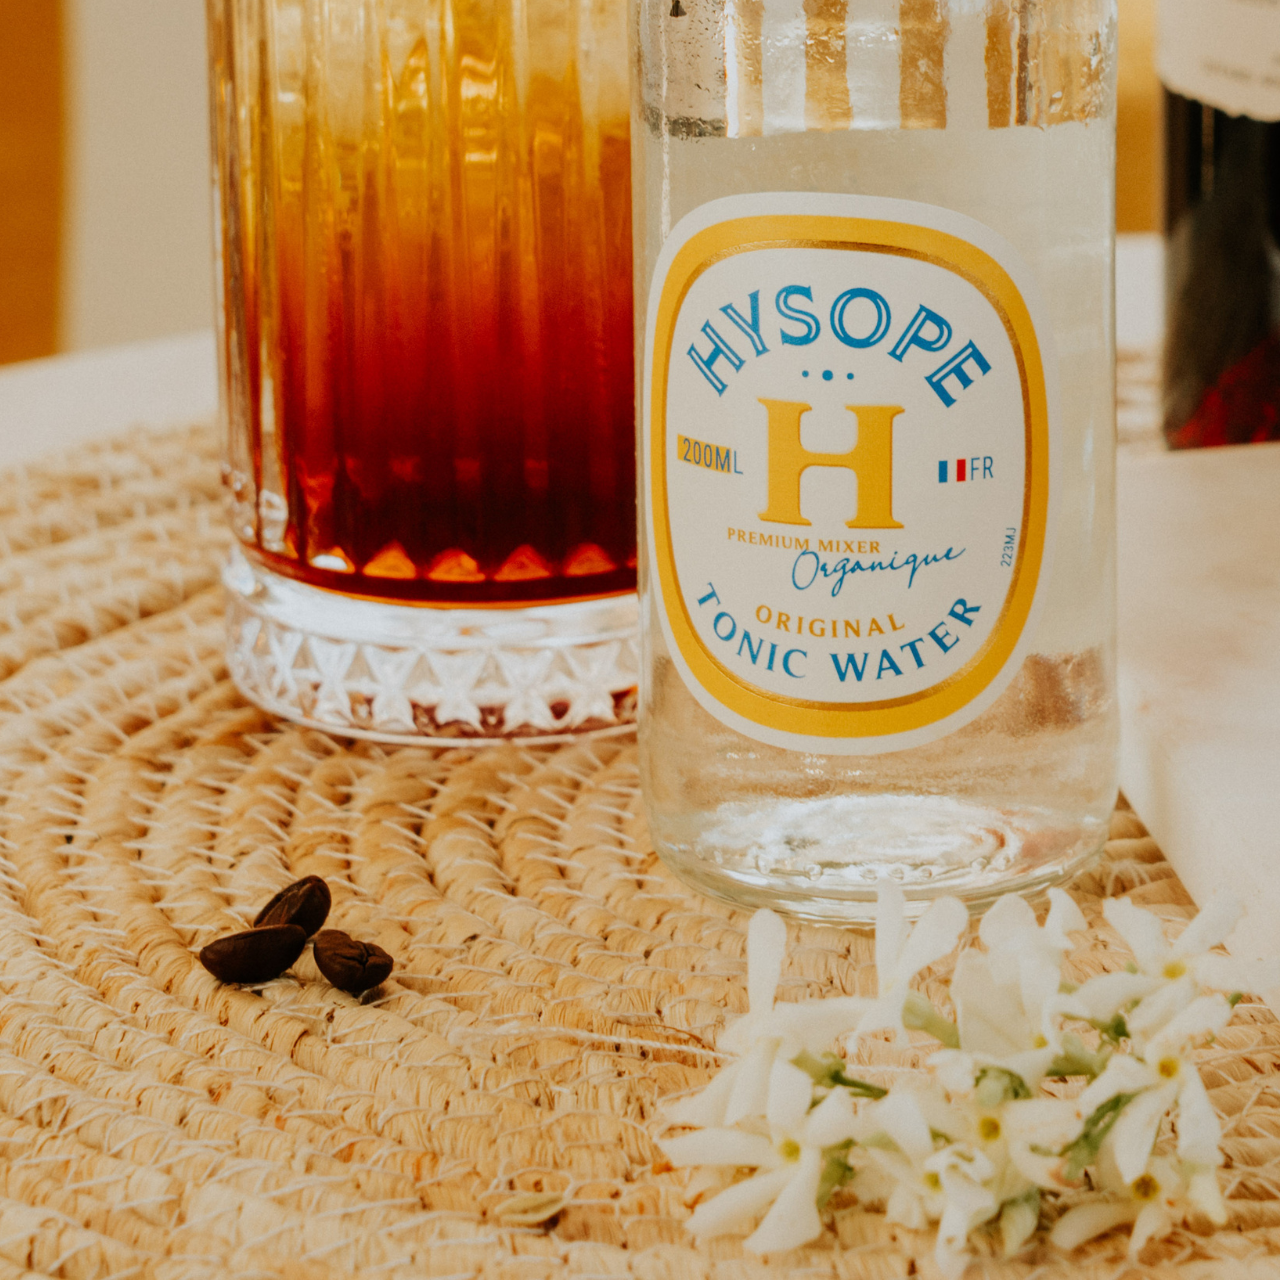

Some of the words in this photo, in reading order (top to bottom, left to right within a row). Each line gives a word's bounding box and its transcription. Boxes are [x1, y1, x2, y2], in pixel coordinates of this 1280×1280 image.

[686, 284, 992, 408] HYSOPE
[682, 437, 744, 475] 200ML
[757, 397, 905, 529] H
[970, 456, 994, 482] FR
[727, 526, 810, 551] PREMIUM
[818, 538, 881, 554] MIXER
[1000, 526, 1017, 568] 223MJ
[791, 546, 966, 597] Organique
[697, 582, 808, 678] TONIC
[829, 597, 982, 682] WATER
[755, 604, 905, 638] ORIGINAL
